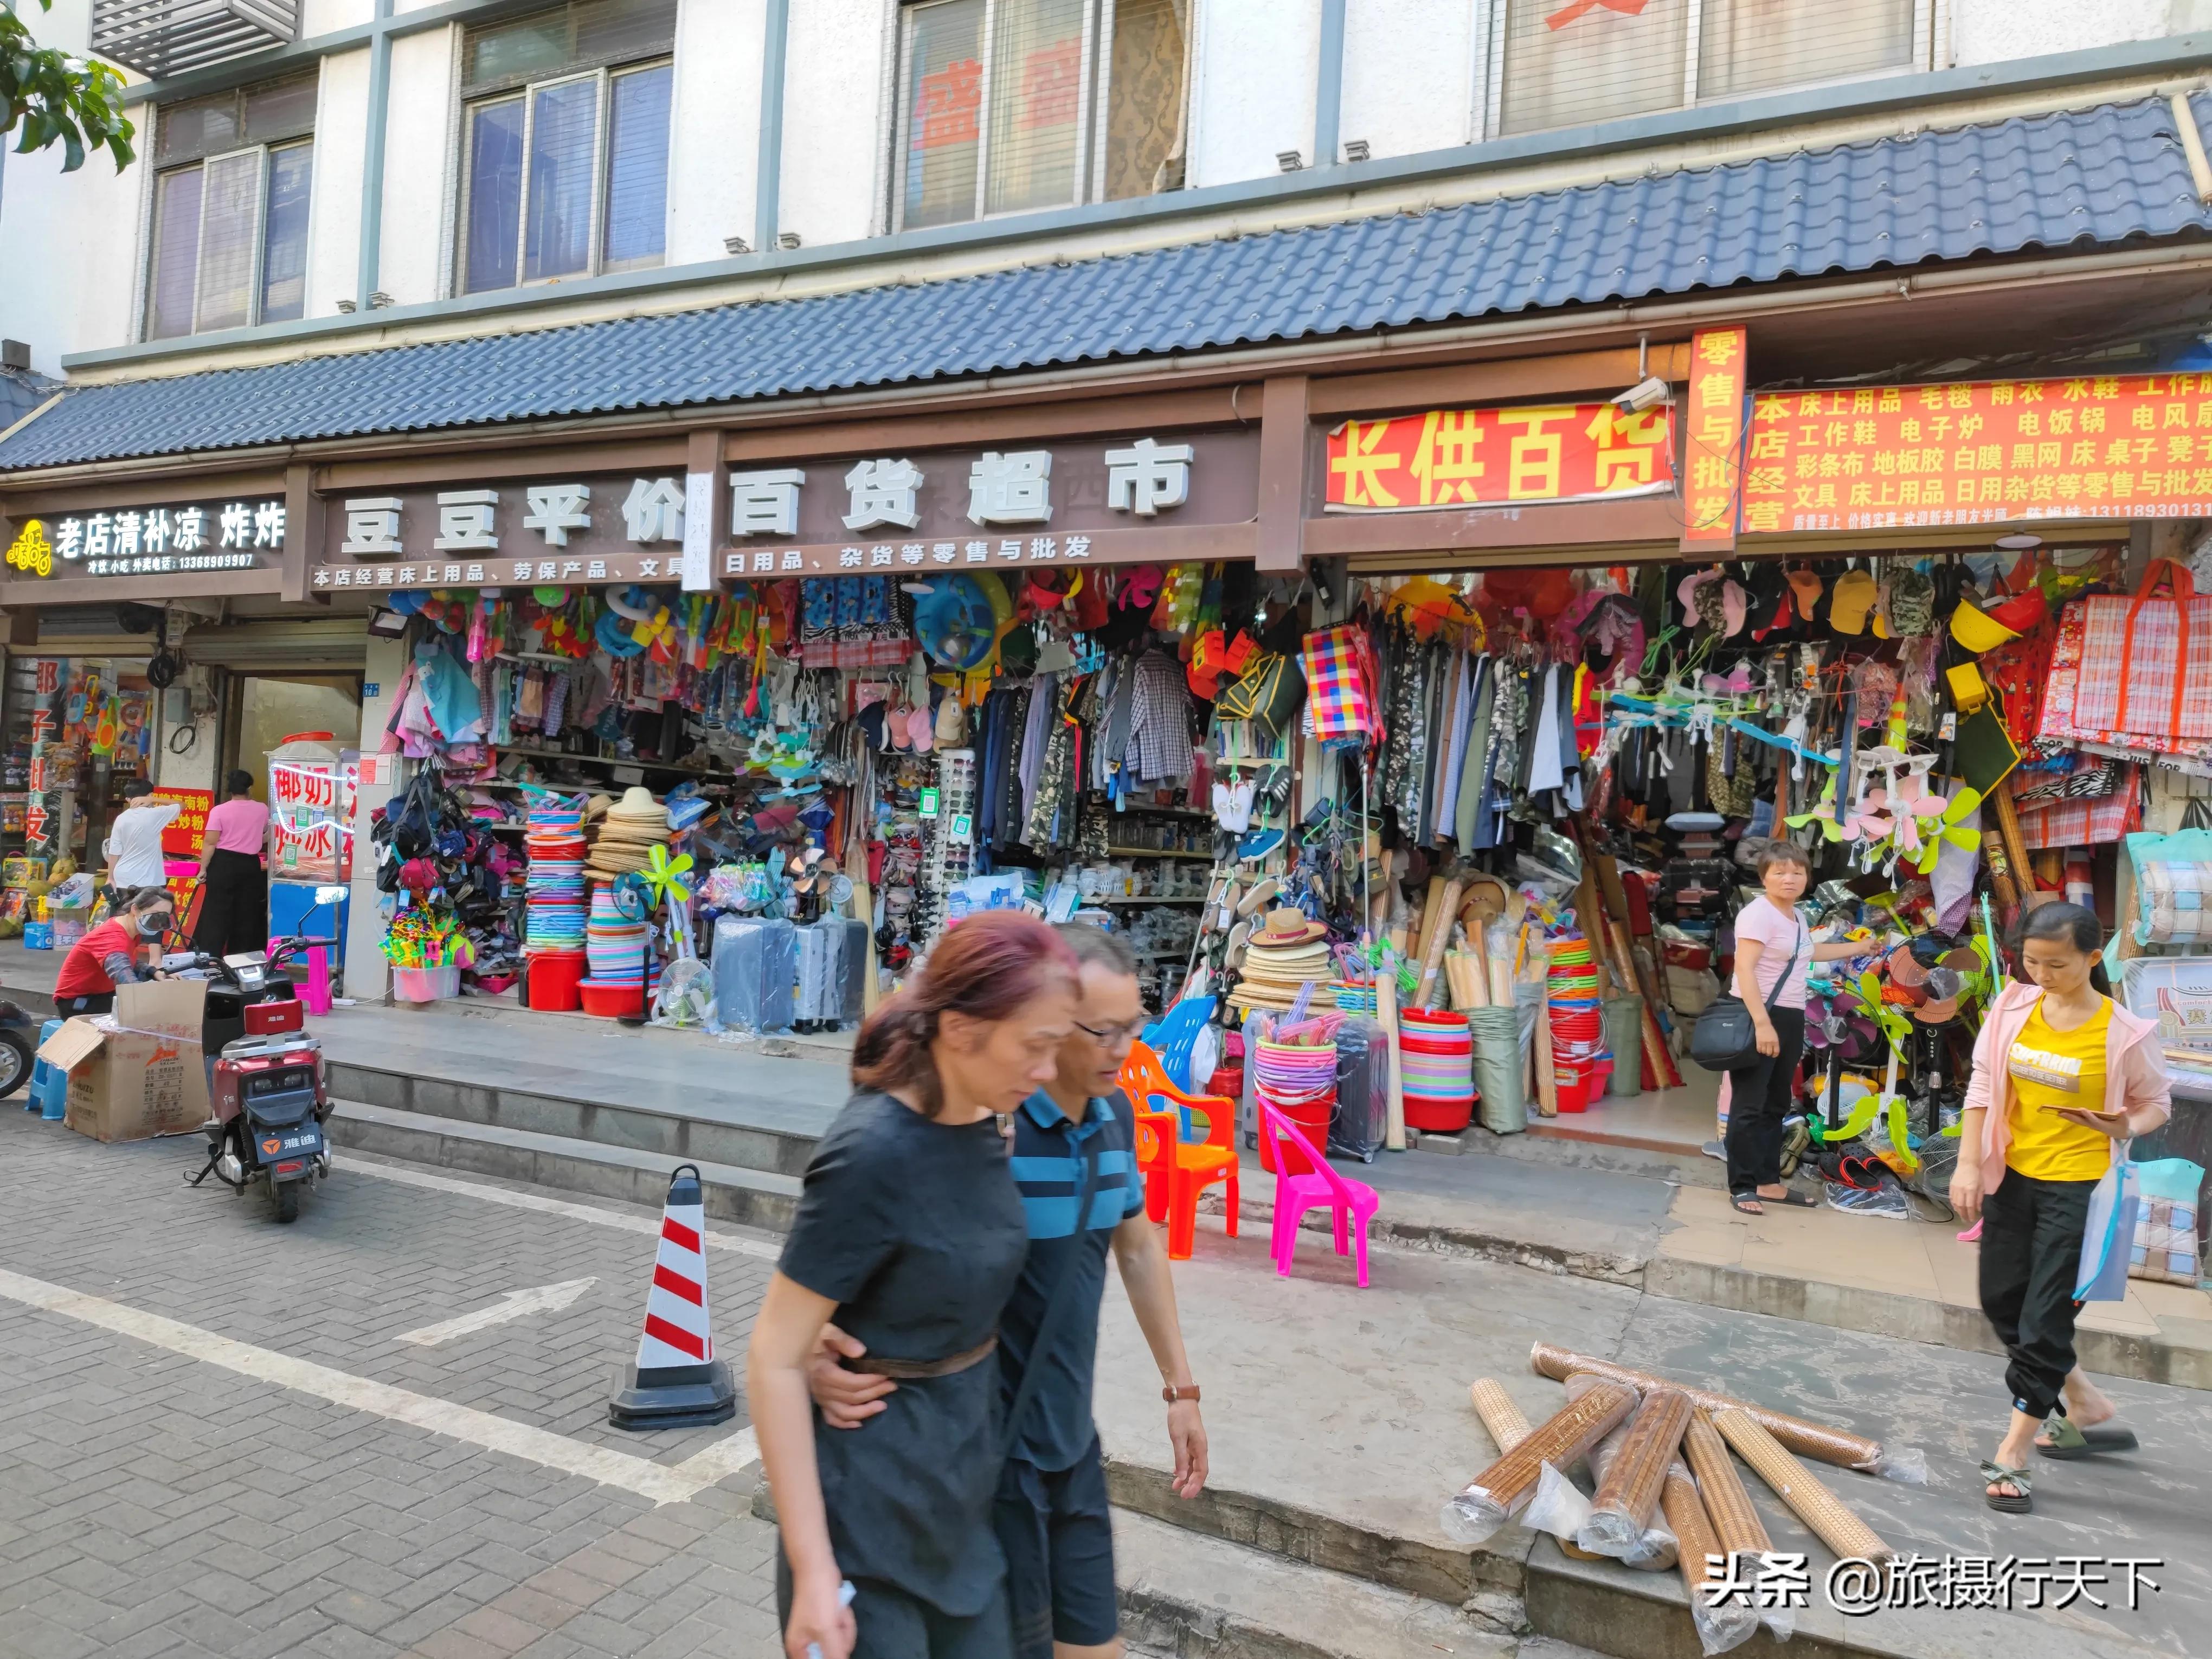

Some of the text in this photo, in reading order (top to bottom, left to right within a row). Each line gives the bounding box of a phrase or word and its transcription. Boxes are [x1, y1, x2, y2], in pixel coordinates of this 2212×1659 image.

[1798, 387, 1901, 418] 床上用品
[1919, 383, 1973, 411] 毛毯
[1991, 381, 2045, 406] 雨衣
[2062, 376, 2120, 402] 水鞋
[1693, 331, 1738, 532] 零售与批发
[1796, 420, 1877, 447] 工作鞋
[1900, 413, 1983, 443] 电子炉
[2017, 406, 2106, 437] 电饭锅
[1331, 403, 1667, 507] 长供百货
[1744, 394, 1791, 531] 本店经营
[1795, 451, 1866, 479] 彩条布
[1872, 446, 1946, 475] 地板胶
[1954, 443, 2003, 471] 白膜
[2010, 441, 2062, 470] 黑网
[2069, 439, 2097, 467] 床
[2104, 437, 2159, 466] 桌子
[342, 477, 685, 554] 豆豆平价
[729, 438, 1194, 538] 百货超市
[1791, 467, 2212, 510] 文具 床上用品 日用杂货等零售与批发
[56, 506, 202, 558] 老店清补凉
[219, 501, 286, 548] 炸炸
[111, 560, 129, 574] 小吃
[726, 536, 1092, 573] 日用品、杂货等零售与批发
[284, 1134, 317, 1150] 雅迪
